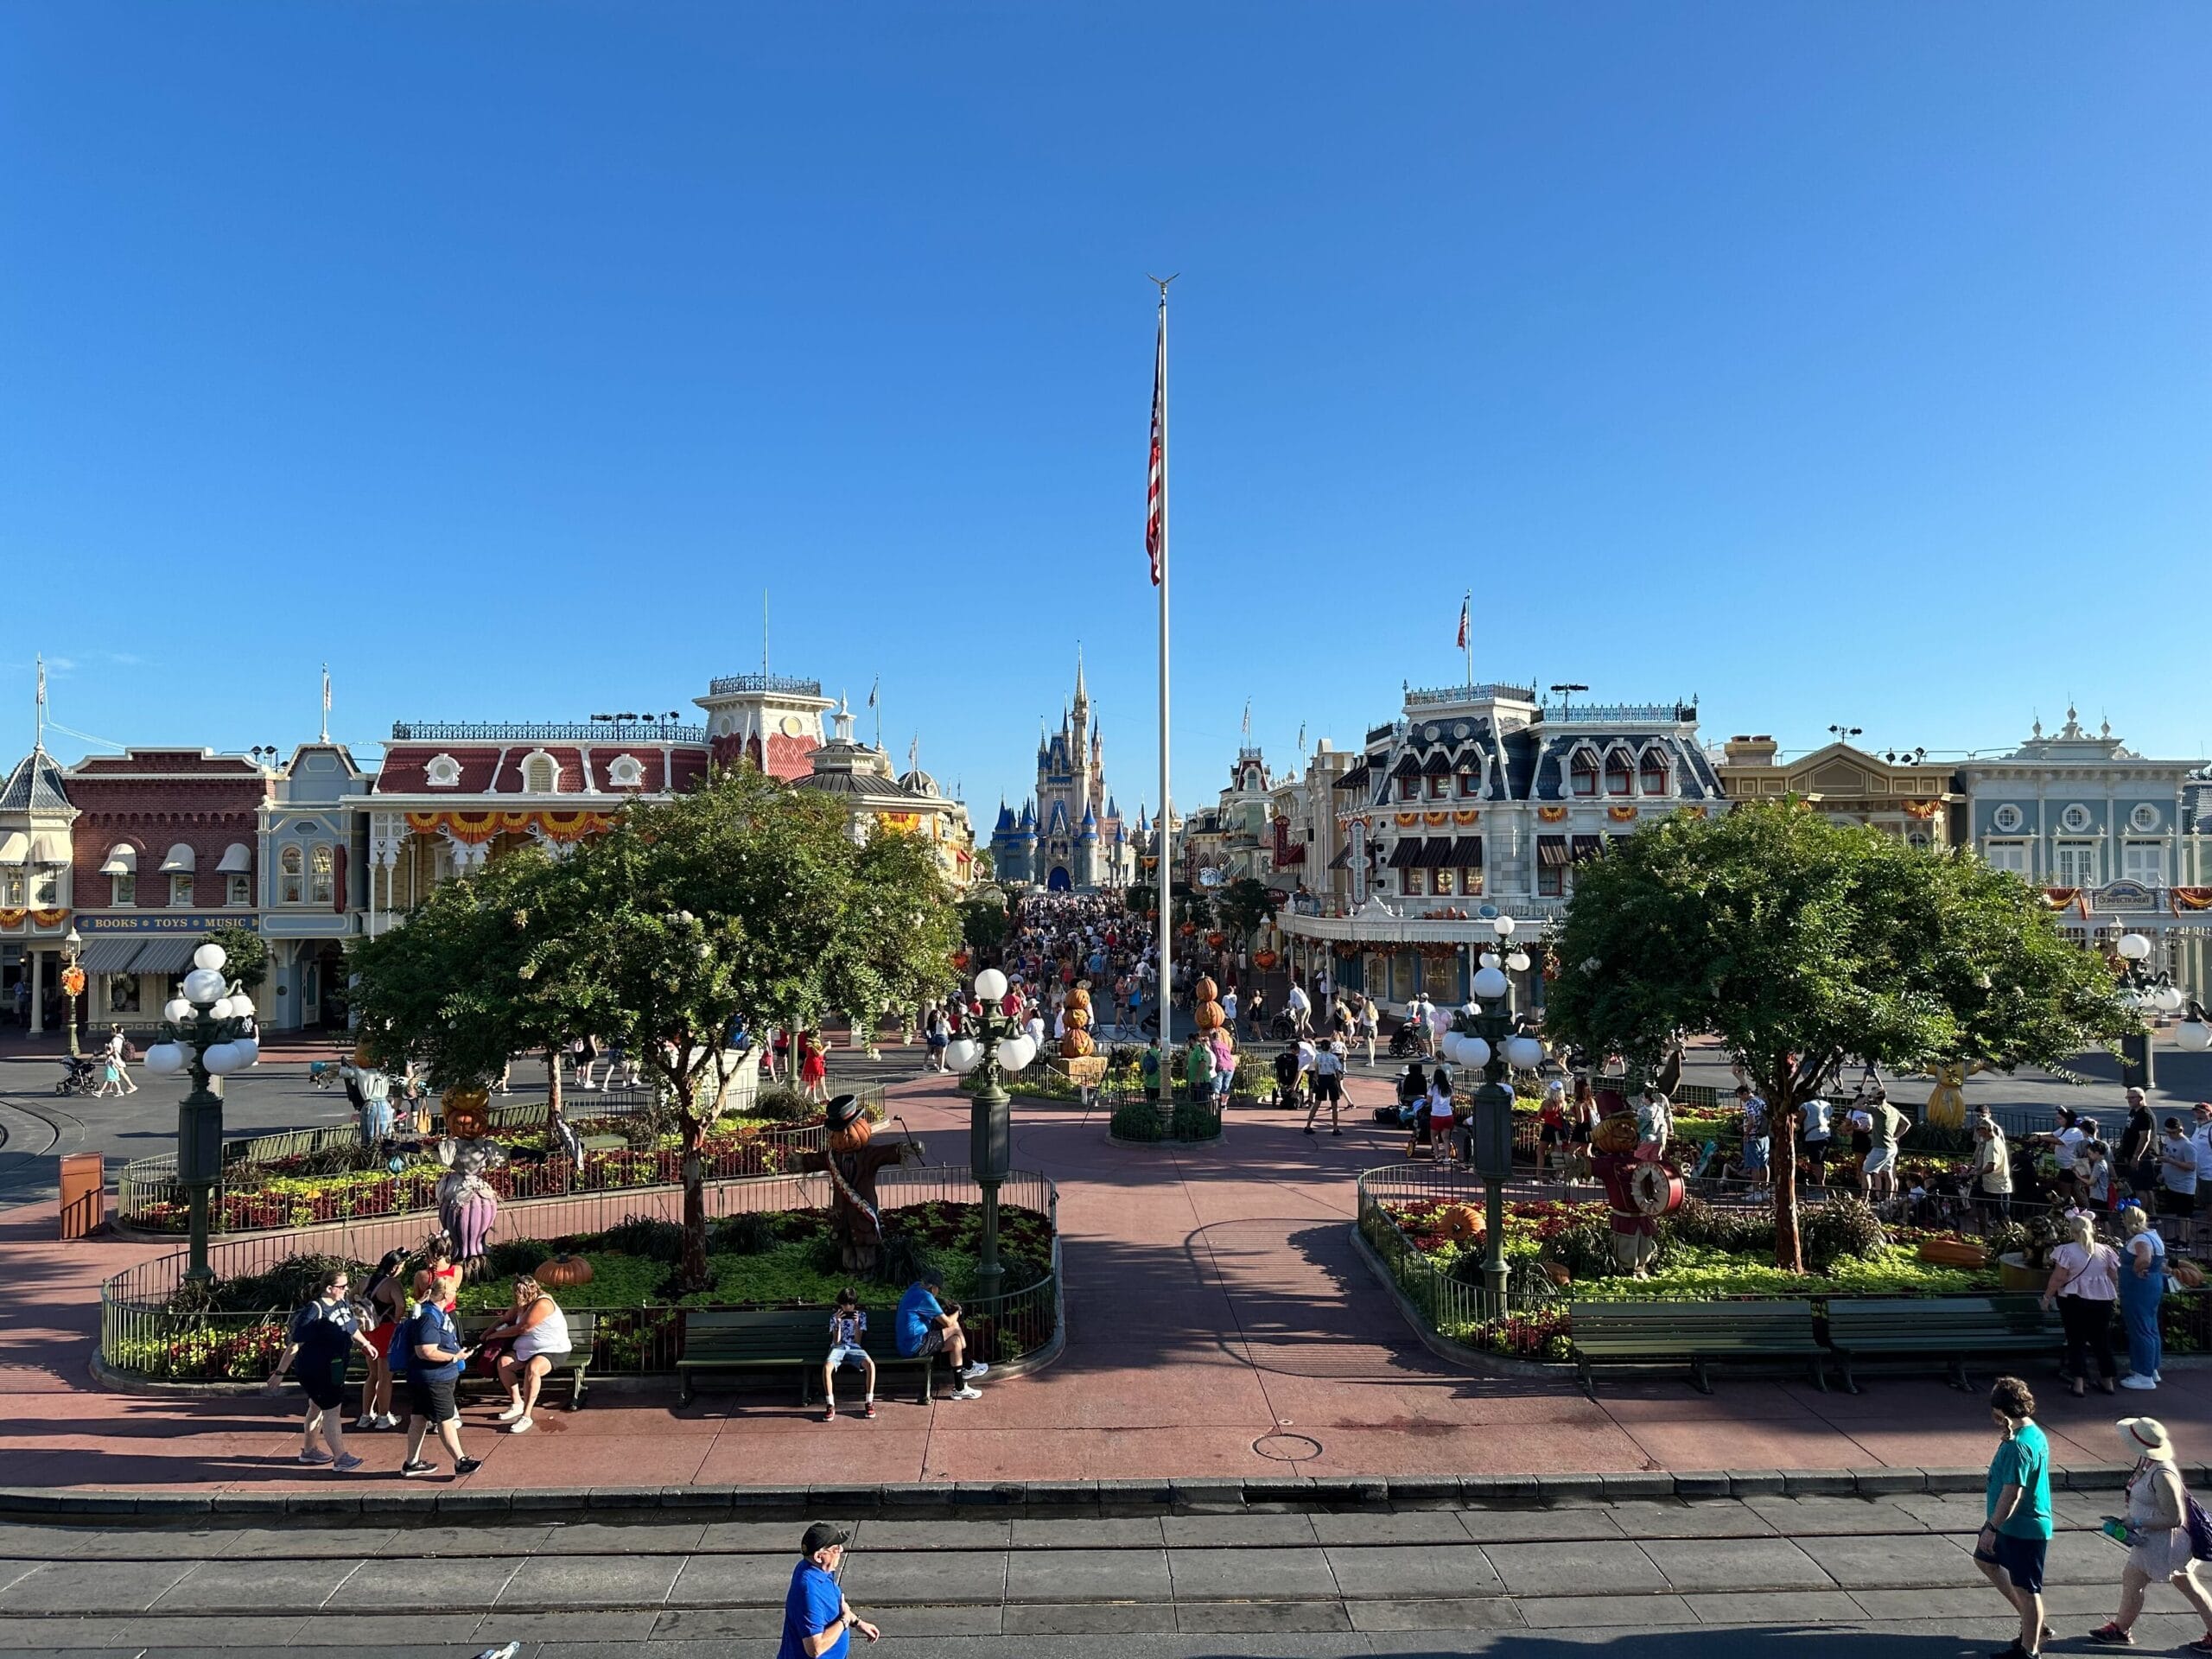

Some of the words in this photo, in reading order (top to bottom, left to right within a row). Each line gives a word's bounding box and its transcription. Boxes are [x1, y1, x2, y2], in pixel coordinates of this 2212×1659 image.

[95, 918, 137, 928] BOOKS
[154, 918, 188, 927] TOYS
[205, 918, 246, 927] MUSIC
